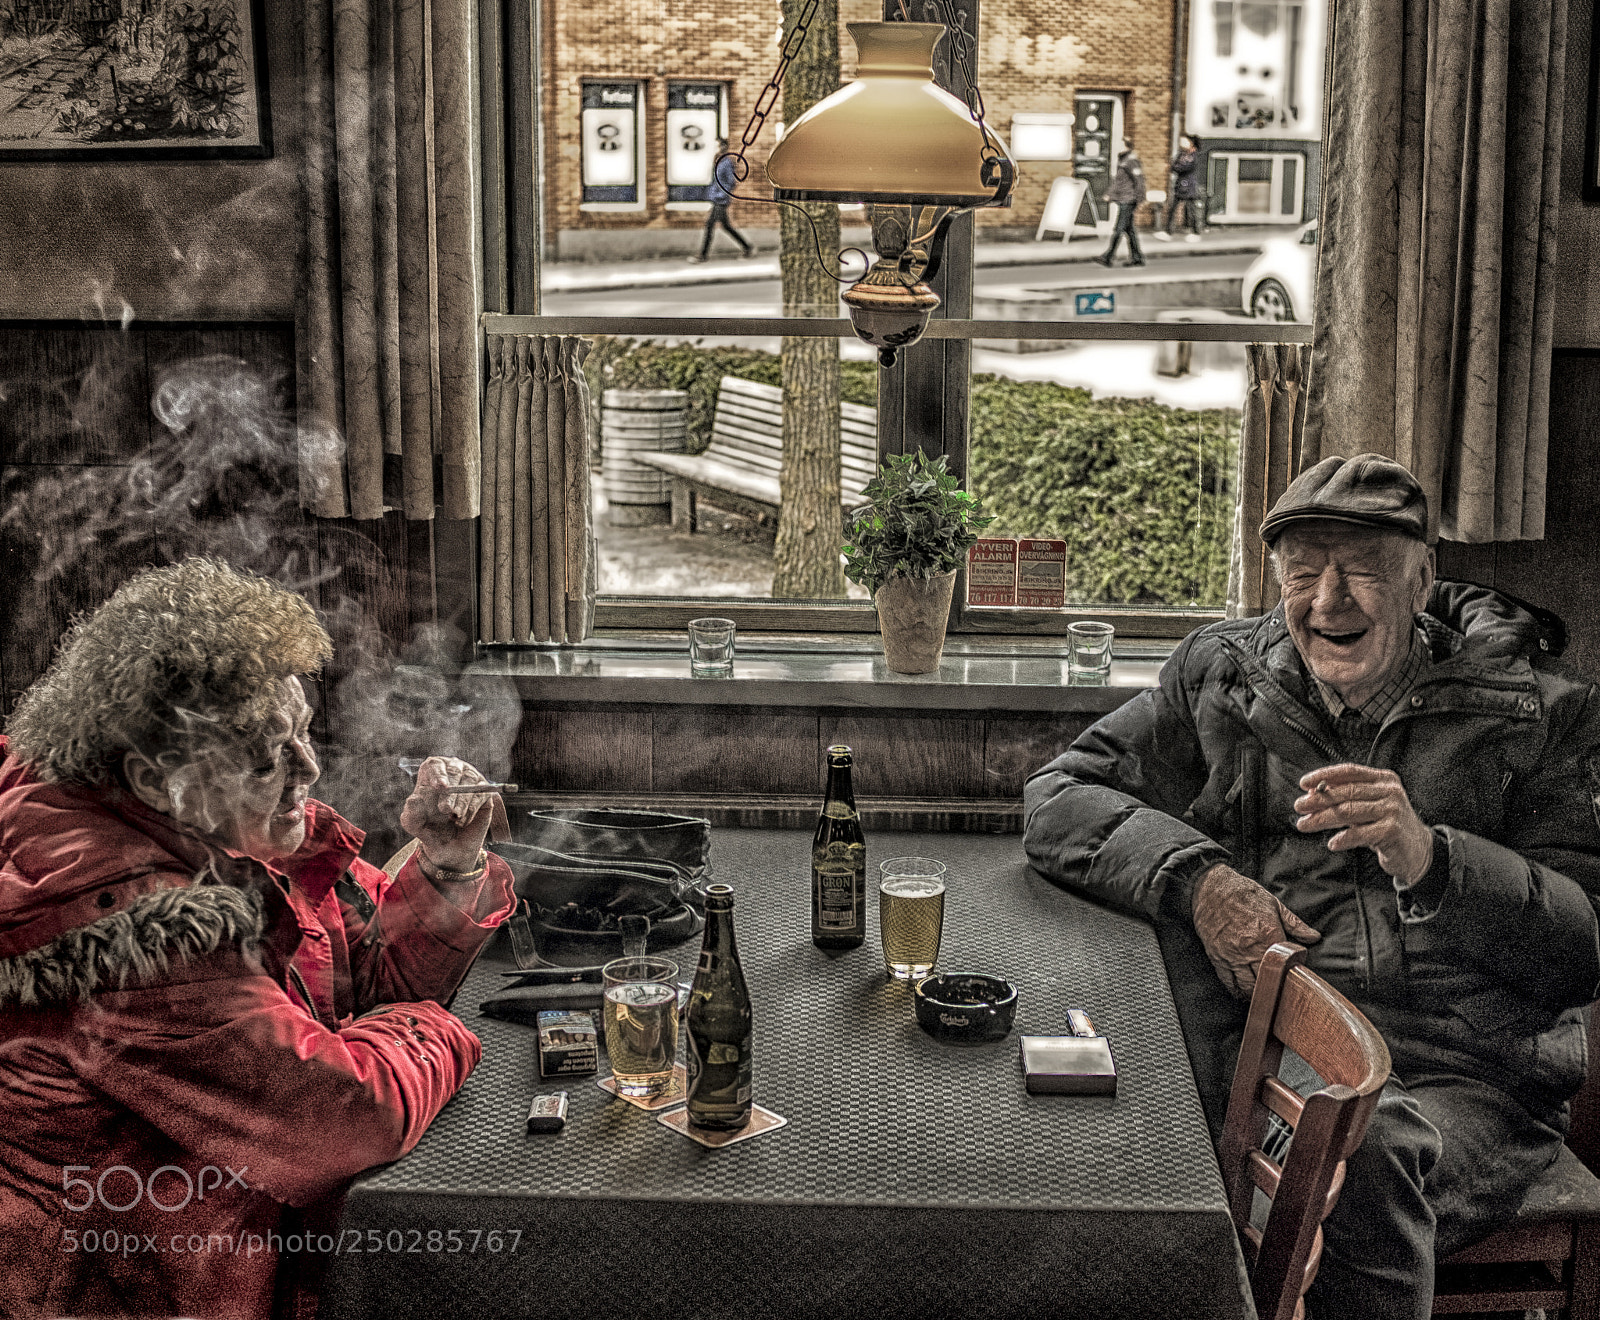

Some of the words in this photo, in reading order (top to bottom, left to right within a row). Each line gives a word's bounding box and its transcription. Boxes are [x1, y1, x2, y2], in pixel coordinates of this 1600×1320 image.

[974, 543, 1013, 552] TYVERI
[1031, 542, 1053, 551] VIDEO-
[973, 552, 1012, 561] ALARM
[1019, 551, 1065, 561] OVERVÅGNING
[971, 592, 981, 602] 76
[984, 593, 997, 603] 117
[1000, 593, 1014, 603] 117
[1030, 597, 1039, 605] 70
[822, 877, 851, 888] GRØN
